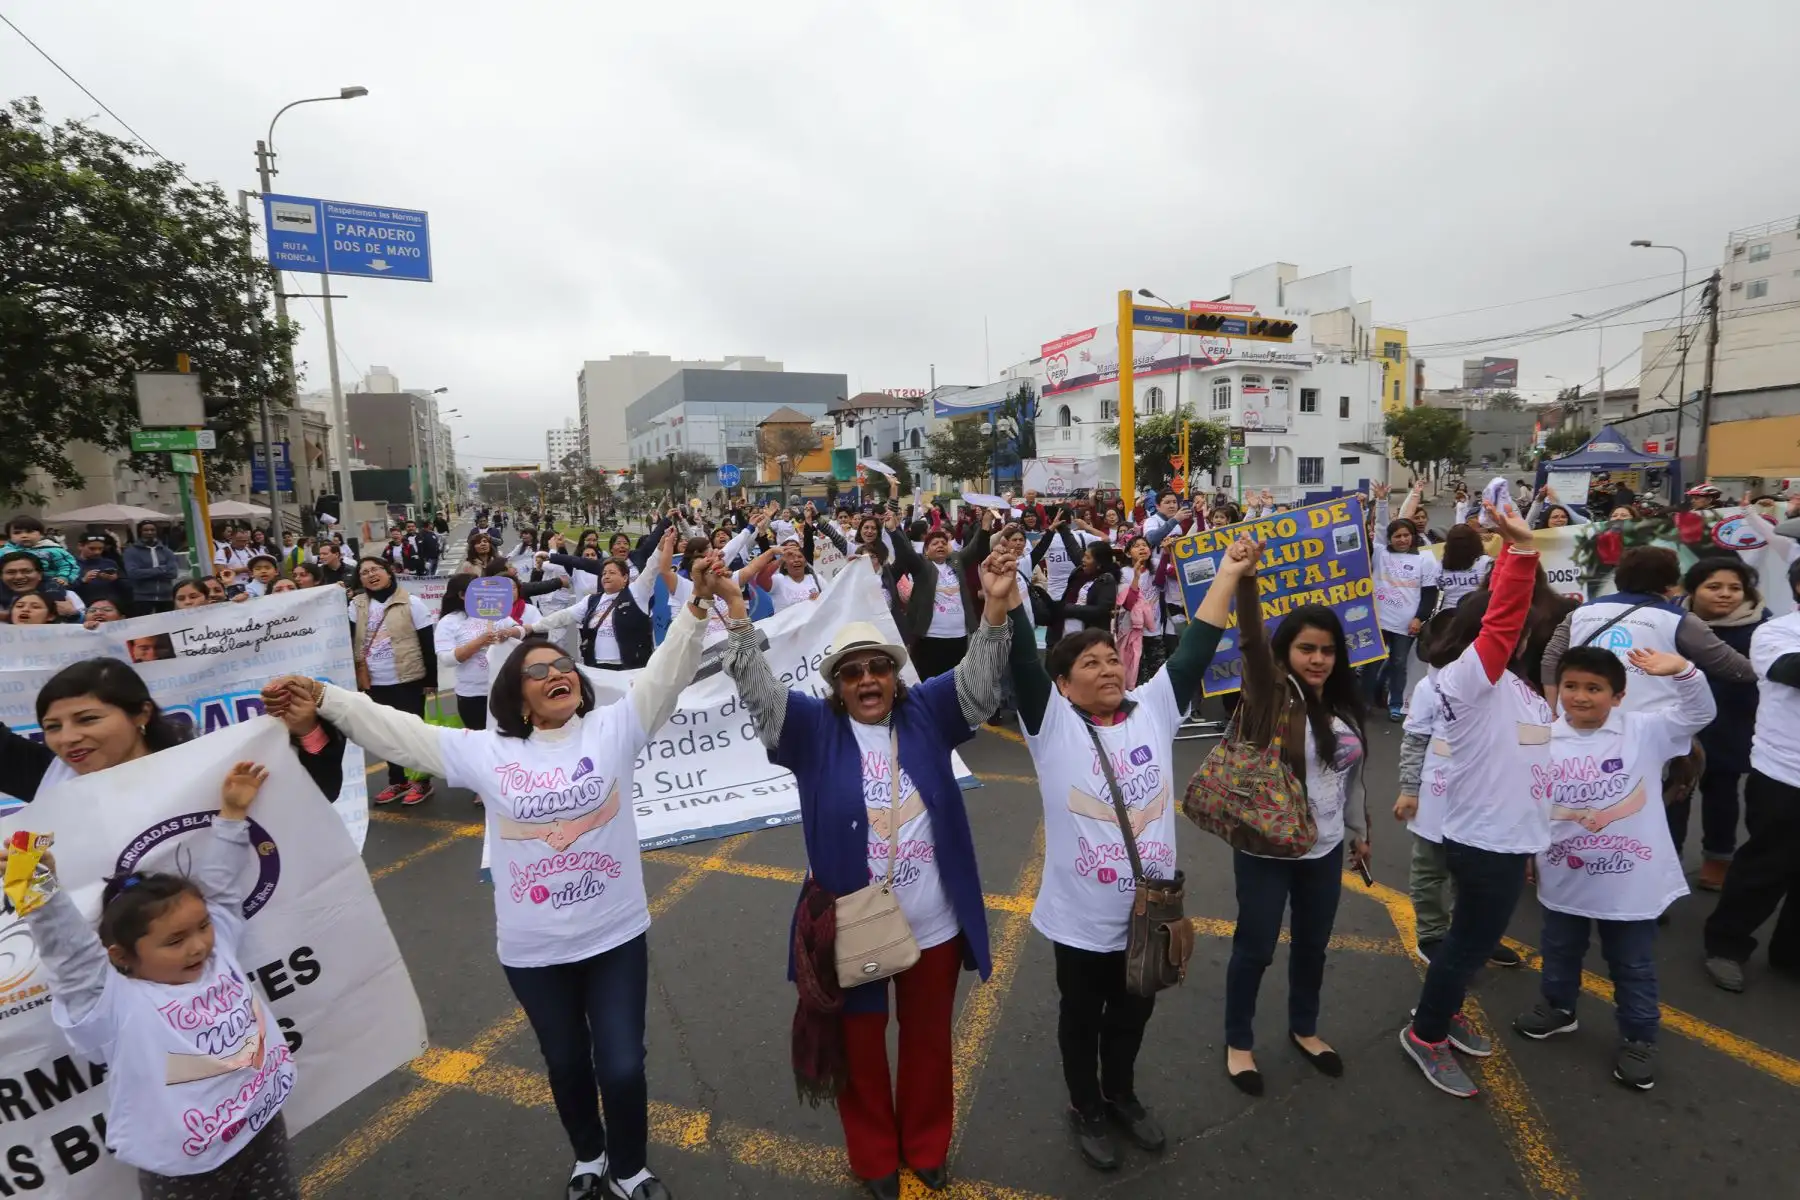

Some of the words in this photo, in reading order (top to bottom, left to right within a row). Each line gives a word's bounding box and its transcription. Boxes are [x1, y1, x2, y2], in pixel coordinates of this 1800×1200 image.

[282, 241, 308, 251] RUTA
[336, 223, 416, 242] PARADERO
[275, 251, 319, 263] TRONCAL
[333, 239, 360, 252] DOS
[365, 243, 381, 255] DE
[387, 245, 421, 258] MAYO
[1207, 346, 1233, 355] PERU
[1051, 369, 1069, 379] PERU
[1174, 517, 1297, 559] CENTRO
[1308, 502, 1351, 530] DE
[1048, 551, 1070, 562] Sal
[1437, 573, 1480, 587] Salud
[171, 618, 264, 646] Trabajando
[265, 614, 300, 635] para
[179, 643, 228, 657] todos
[227, 637, 256, 651] los
[250, 627, 316, 653] peruanos
[1135, 748, 1149, 764] MI
[494, 762, 568, 796] TOMA
[655, 767, 708, 794] Sur
[1554, 773, 1631, 804] mano
[513, 776, 604, 819] mano
[663, 791, 746, 813] LIMA
[120, 820, 181, 870] BRIGADAS
[1075, 836, 1176, 878] abraemos
[1586, 850, 1635, 876] vida
[509, 851, 622, 904] abracemos
[551, 870, 605, 910] vida
[158, 973, 245, 1030] TOMA
[249, 1069, 294, 1133] vida
